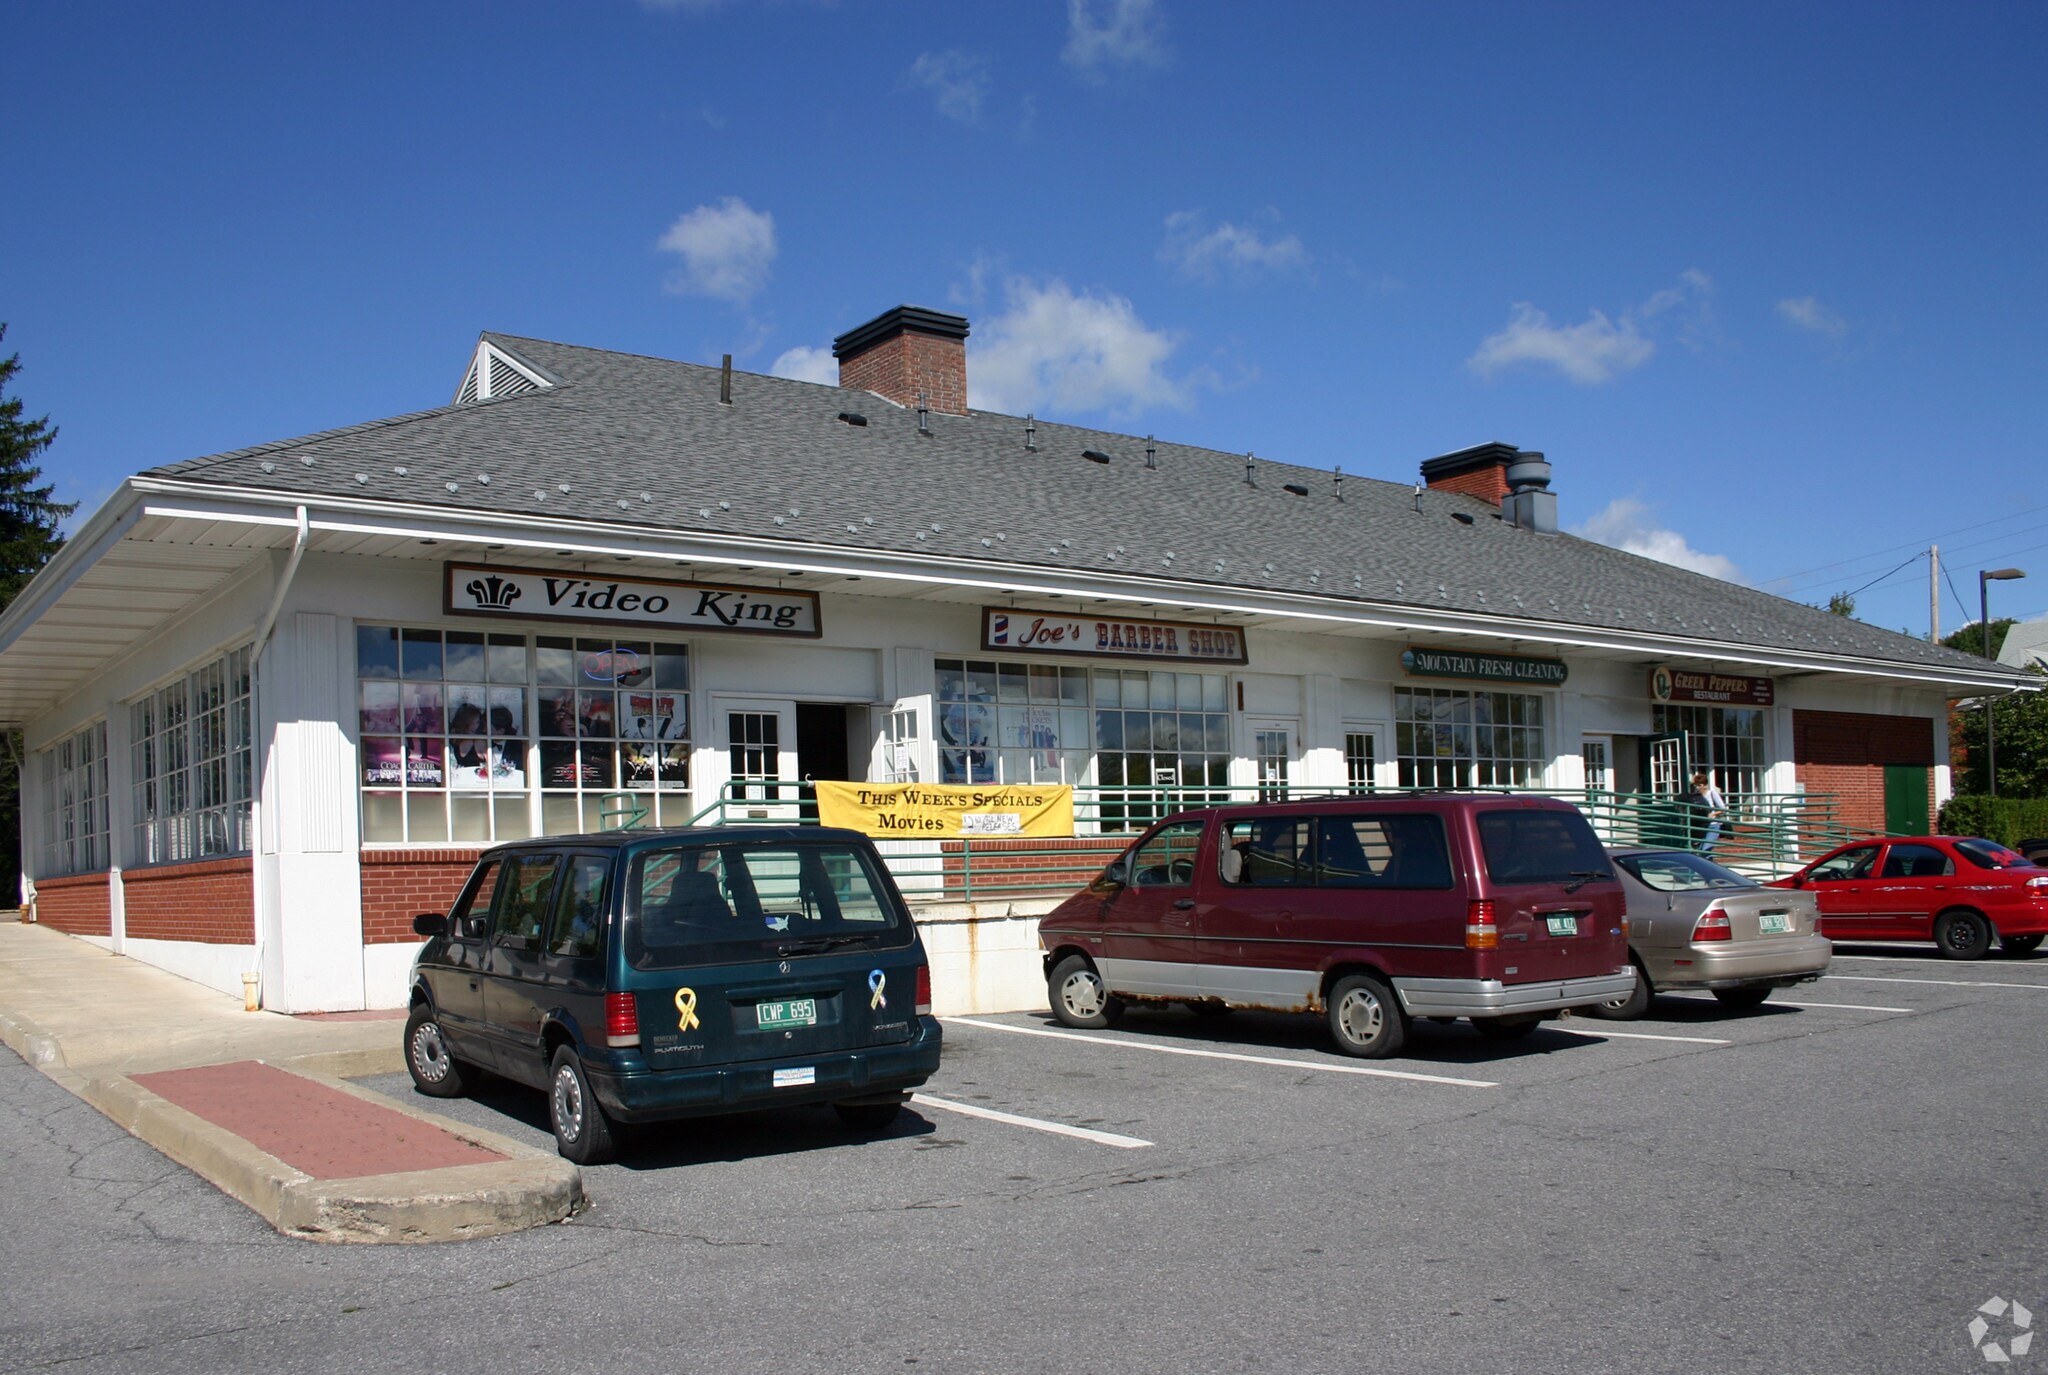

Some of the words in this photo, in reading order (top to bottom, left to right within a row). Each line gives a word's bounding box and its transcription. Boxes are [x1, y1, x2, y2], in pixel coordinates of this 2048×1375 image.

[542, 578, 669, 614] Video
[691, 590, 803, 628] King
[1018, 618, 1080, 646] Joe's
[1095, 622, 1179, 653] BARBER
[1188, 629, 1236, 657] SHOP
[584, 654, 641, 674] OPEN
[1417, 653, 1477, 674] MOUNTAIN
[1478, 658, 1513, 677] FRESH
[1514, 661, 1564, 680] CLEANING
[1674, 672, 1705, 690] GREEN
[1708, 675, 1749, 693] PEPPERS
[1693, 690, 1731, 701] RESTAURANT
[407, 761, 436, 771] CARTER
[857, 790, 896, 805] THIS
[902, 790, 967, 806] WEEK'S
[972, 792, 1043, 807] SPECIALS
[878, 813, 944, 831] Movies
[996, 815, 1014, 825] NEW
[762, 1004, 784, 1021] CWP
[790, 1001, 812, 1018] 695
[654, 1044, 705, 1054] PLYMOUTH
